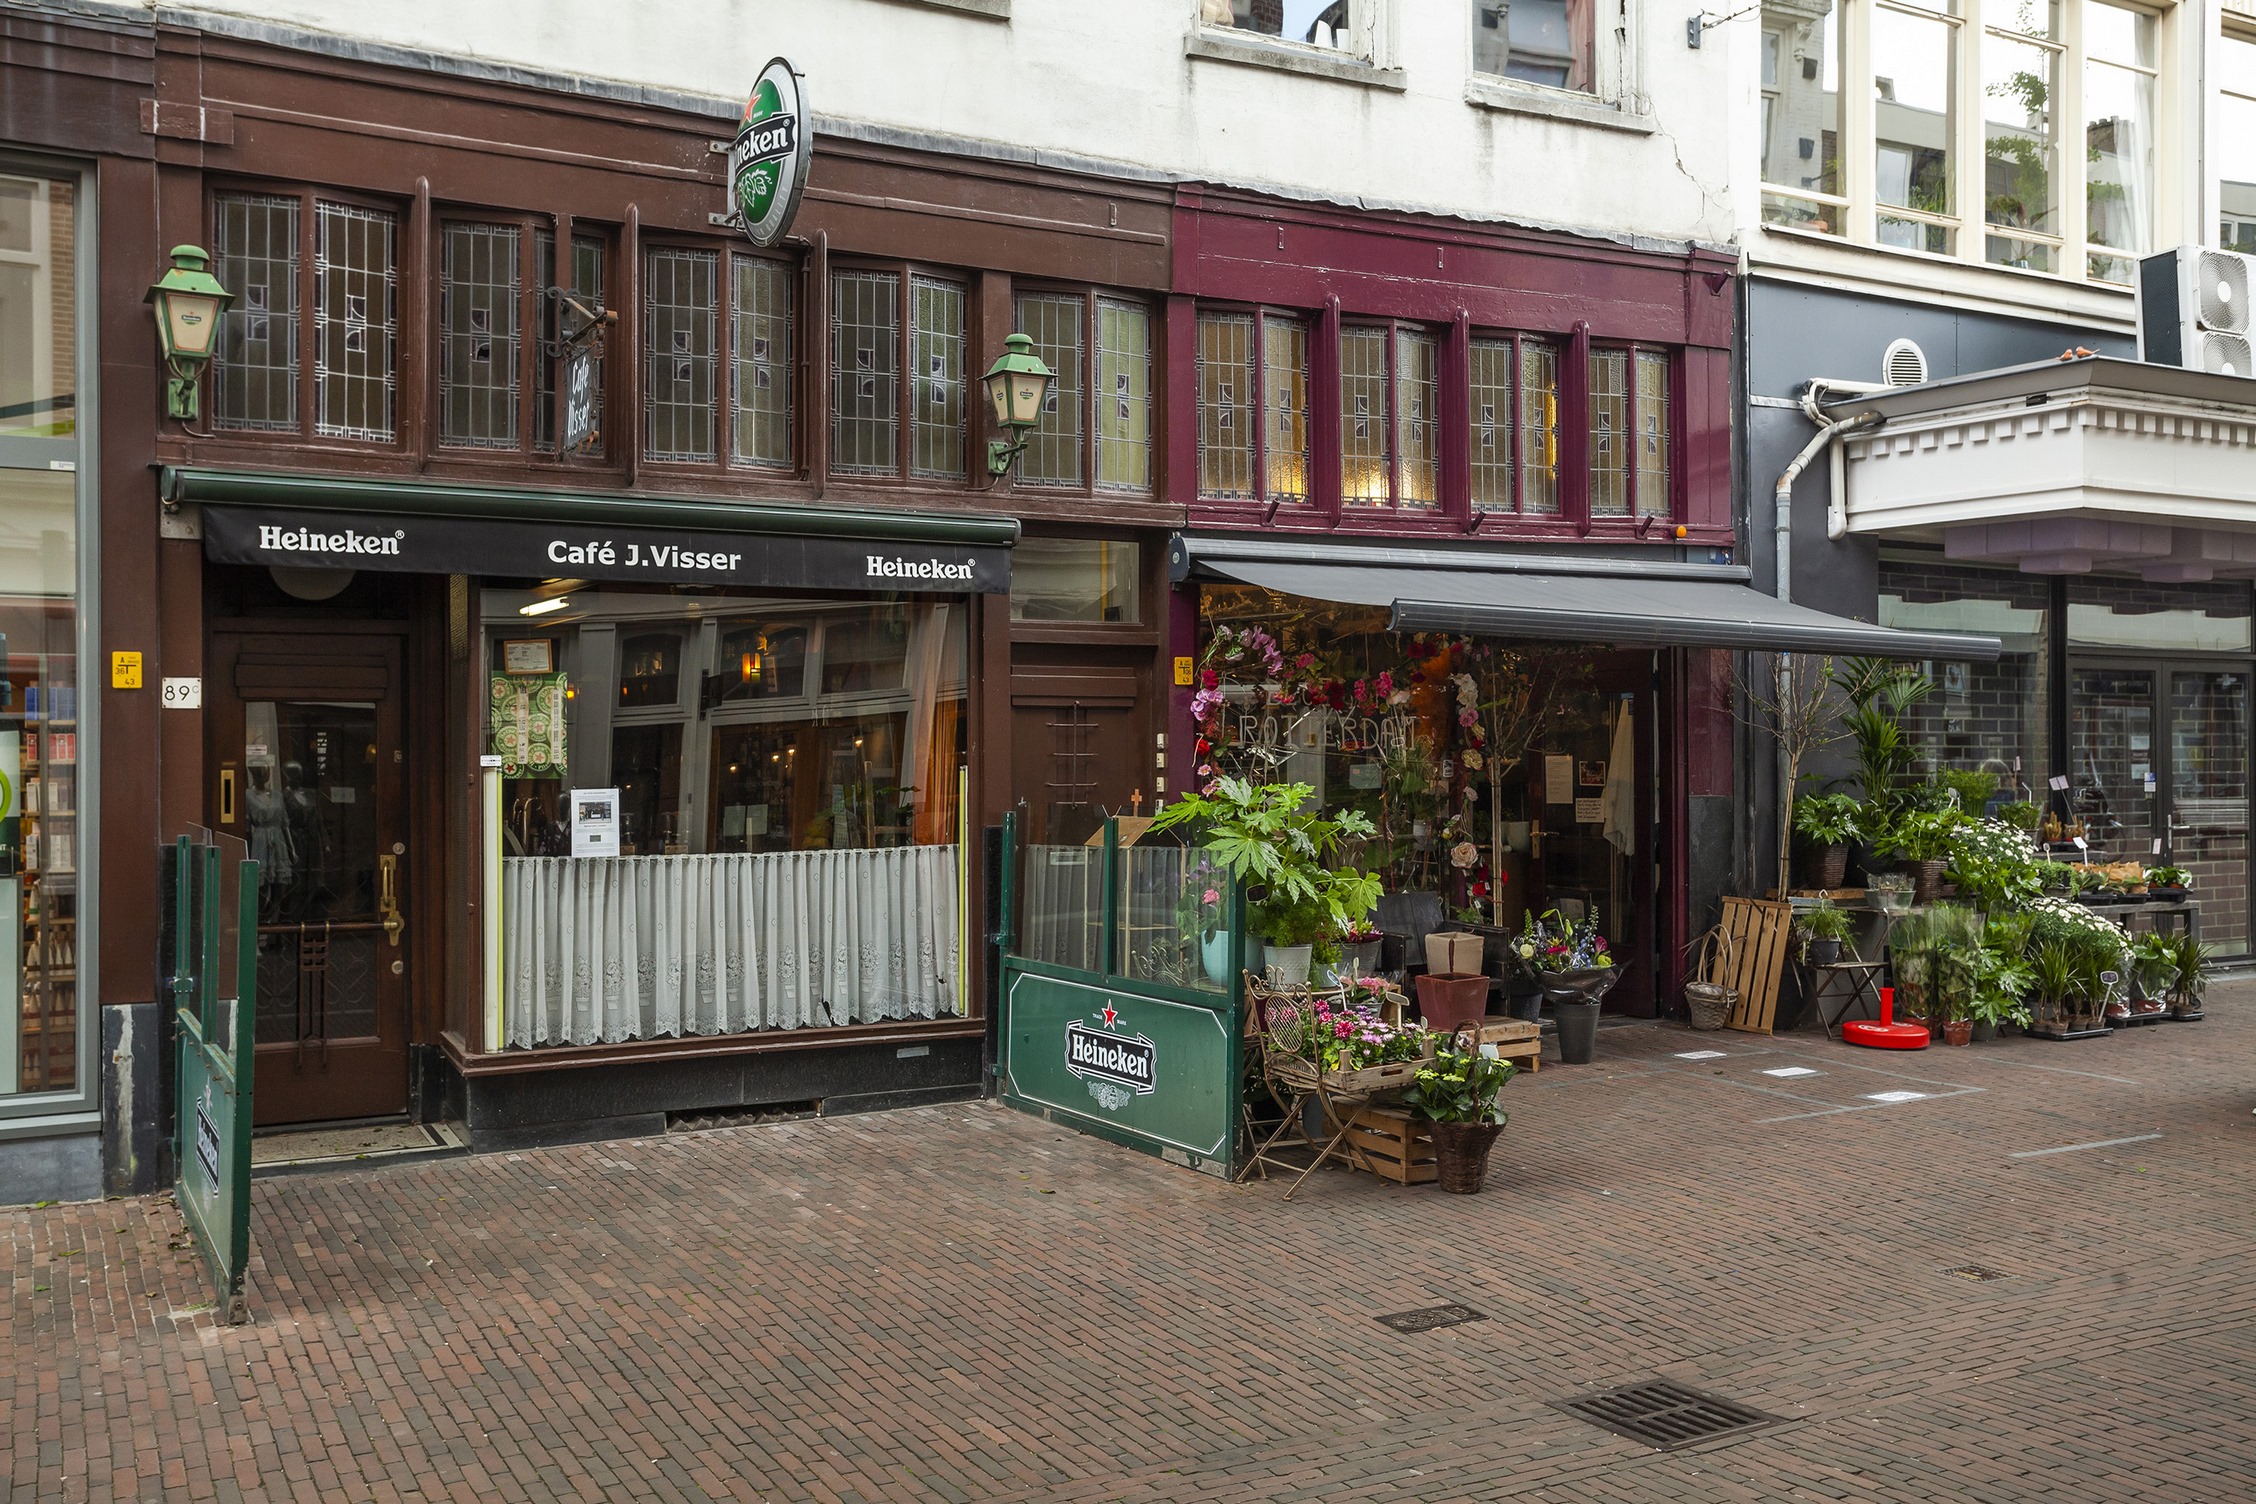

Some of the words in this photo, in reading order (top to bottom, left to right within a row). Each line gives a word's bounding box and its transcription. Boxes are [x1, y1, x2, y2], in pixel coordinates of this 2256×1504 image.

[547, 540, 616, 566] Café
[625, 544, 742, 570] J.Visser
[125, 678, 135, 686] 43
